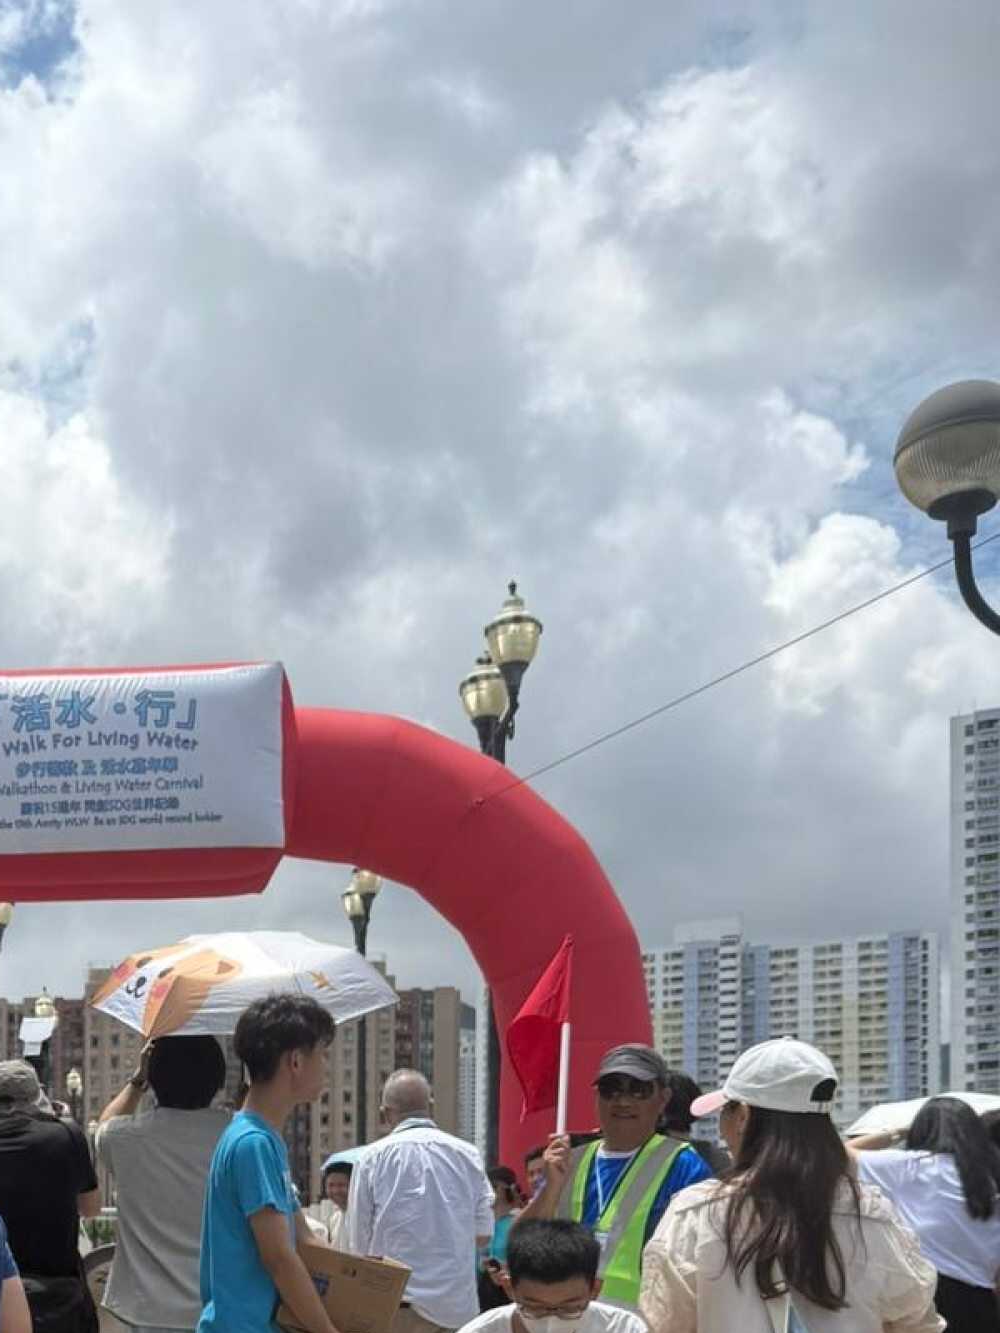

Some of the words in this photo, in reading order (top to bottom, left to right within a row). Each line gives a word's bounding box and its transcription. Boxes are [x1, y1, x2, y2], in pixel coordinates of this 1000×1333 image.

[1, 735, 47, 756] Walk
[53, 734, 81, 748] For
[88, 731, 139, 750] Living
[147, 732, 198, 750] Water
[60, 781, 71, 794] &
[74, 780, 112, 794] Living
[114, 778, 152, 792] Water
[154, 774, 204, 790] Carnival
